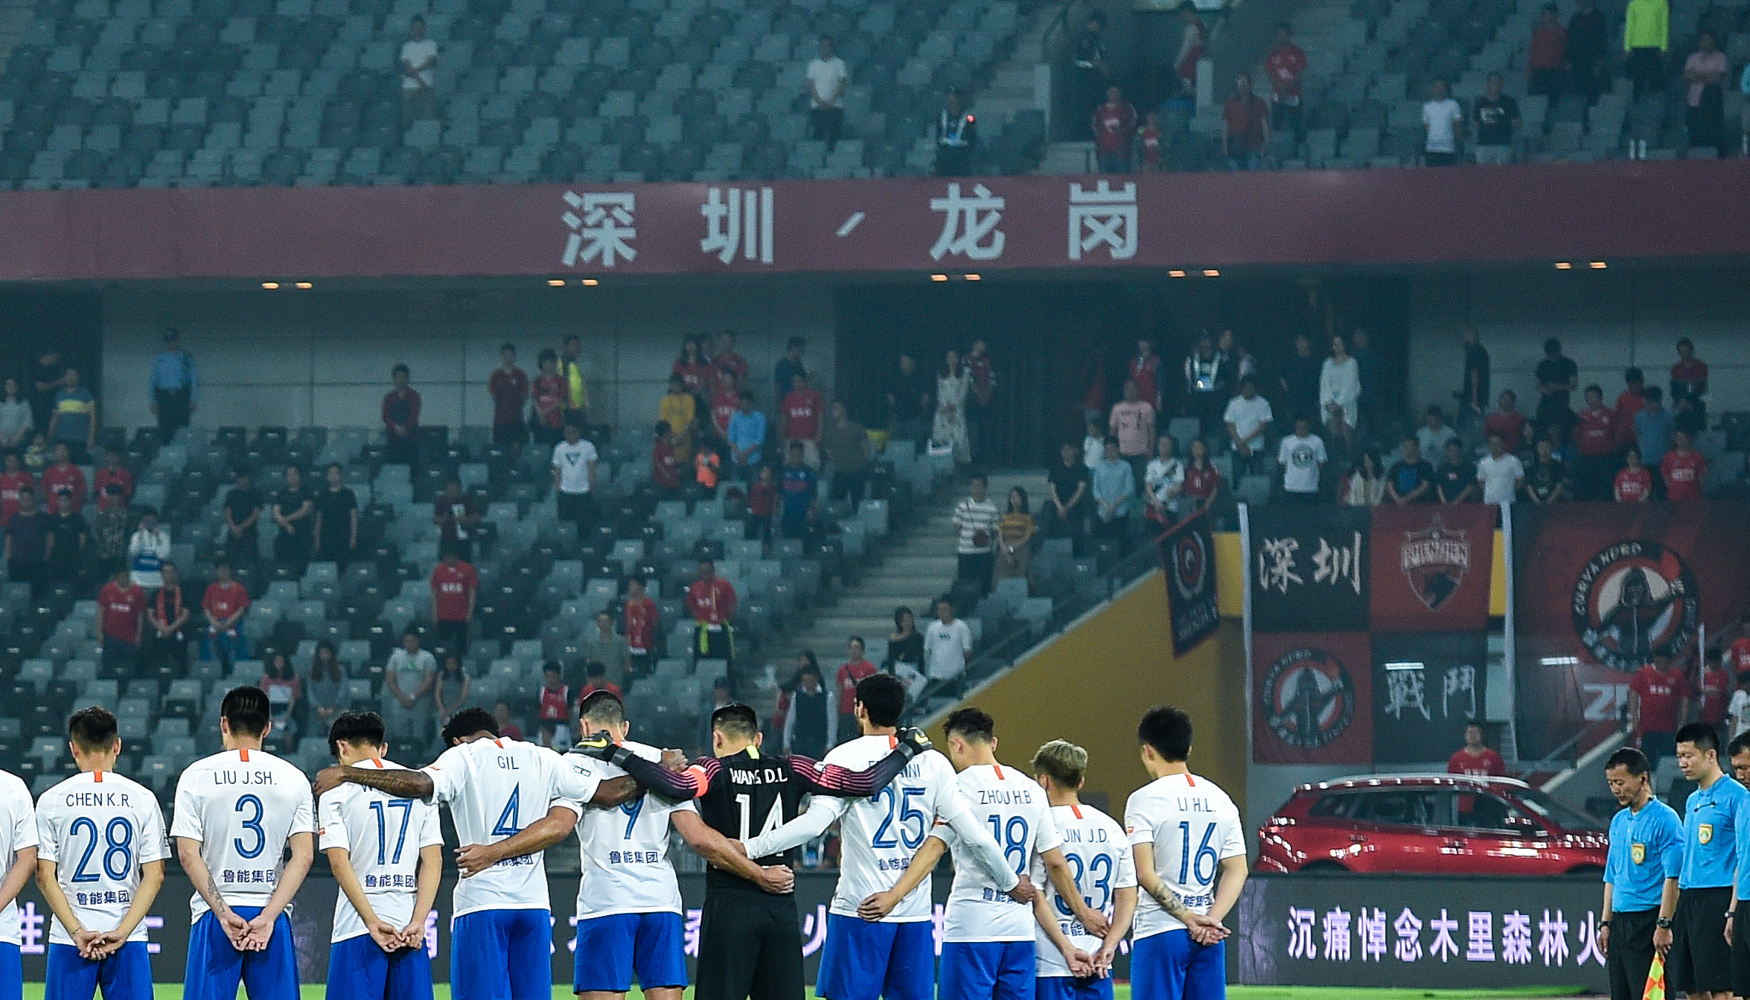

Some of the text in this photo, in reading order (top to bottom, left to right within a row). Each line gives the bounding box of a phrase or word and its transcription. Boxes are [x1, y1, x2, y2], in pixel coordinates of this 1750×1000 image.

[1259, 531, 1362, 595] 深圳
[497, 755, 520, 770] GIL
[214, 771, 278, 786] LIU J.SH.
[729, 767, 762, 785] WANG
[65, 792, 134, 808] CHEN K.R.
[978, 790, 1010, 805] ZHOU
[1177, 797, 1217, 812] LI H.L.
[491, 780, 525, 837] 4
[735, 791, 784, 857] 14
[871, 786, 926, 849] 25
[233, 793, 266, 860] 3
[369, 799, 414, 866] 17
[1063, 828, 1110, 843] JIN J.D.
[70, 816, 133, 883] 28
[609, 850, 659, 865] 鲁能集团
[1178, 821, 1218, 886] 16
[221, 869, 276, 885] 鲁能集团
[365, 874, 418, 889] 鲁能集团
[76, 889, 130, 906] 鲁能集团
[1288, 905, 1607, 967] 沉痛悼念木里森林火
